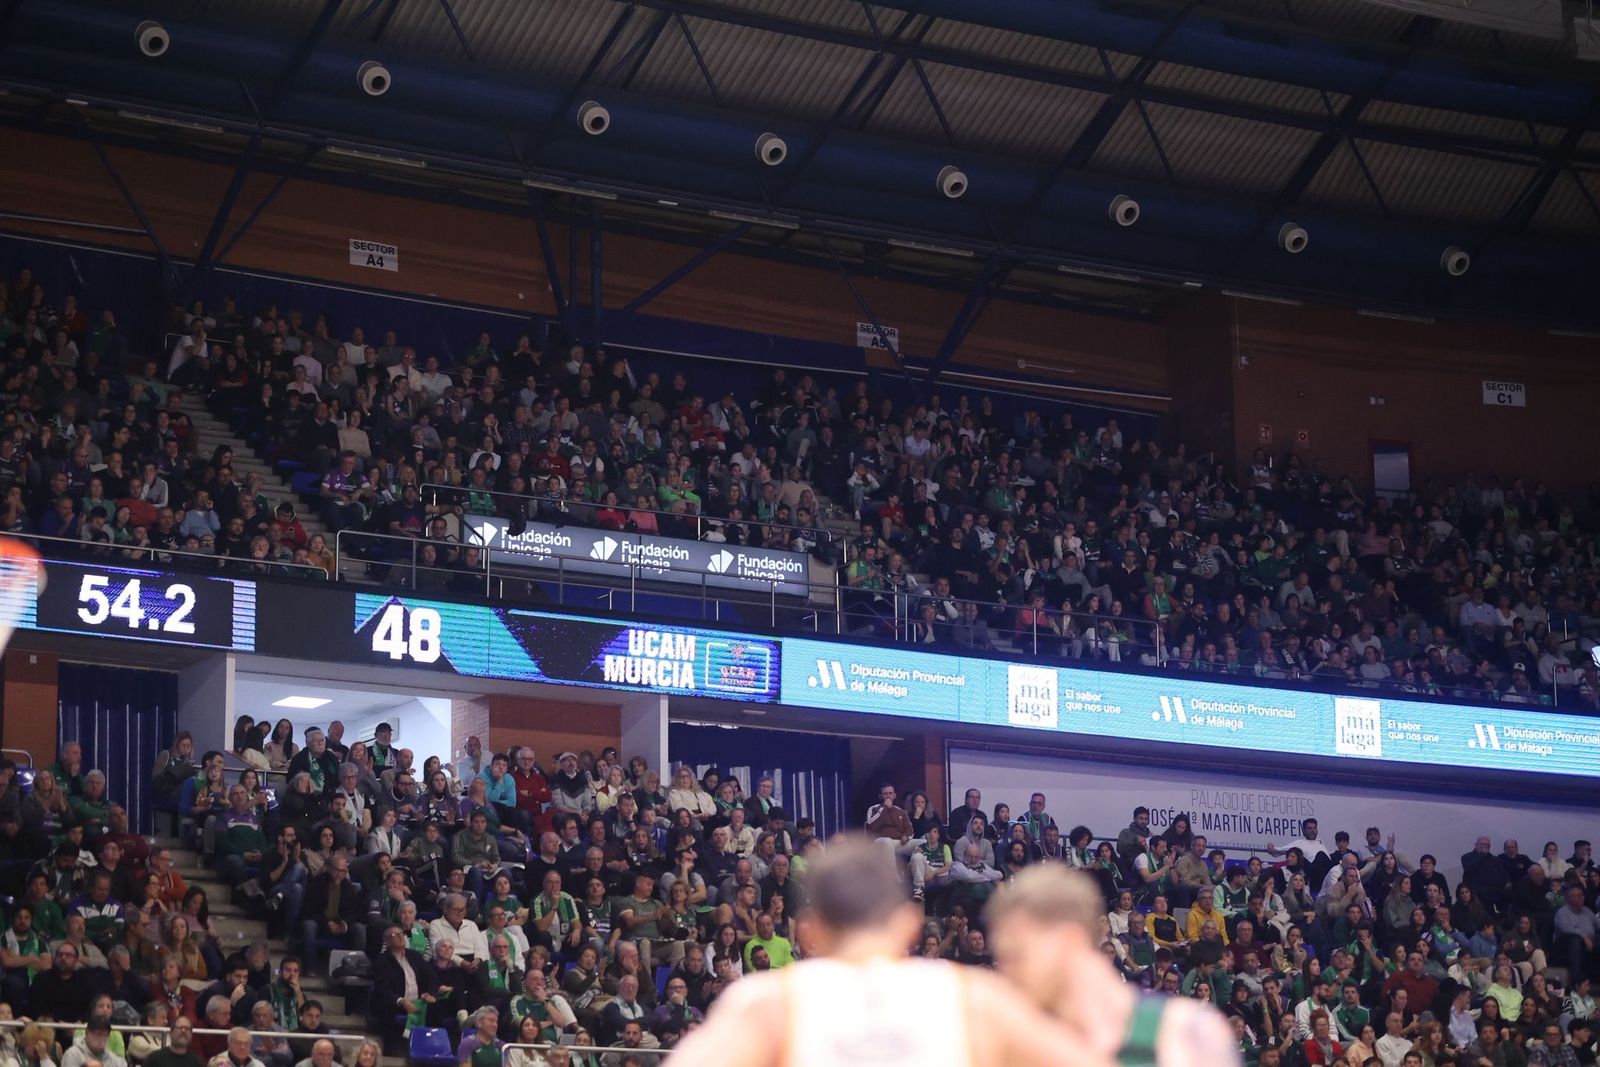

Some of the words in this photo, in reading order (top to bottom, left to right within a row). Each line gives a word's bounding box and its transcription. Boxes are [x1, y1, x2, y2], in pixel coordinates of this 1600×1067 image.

[353, 241, 395, 255] SECTOR
[366, 254, 384, 267] A4
[860, 324, 896, 337] SECTOR
[1486, 383, 1523, 392] SECTOR
[1497, 393, 1512, 404] C1
[621, 541, 689, 560] Fundación
[737, 554, 803, 573] Fundación
[77, 574, 196, 634] 54.2
[372, 604, 441, 663] 48
[628, 629, 696, 661] UCAM
[604, 654, 695, 689] MURCIA
[850, 663, 910, 680] Diputación
[912, 669, 966, 687] Provincial
[850, 680, 865, 692] de
[867, 681, 908, 698] Málaga
[1014, 694, 1051, 722] laga
[1065, 702, 1083, 712] que
[1085, 703, 1102, 712] nos
[1104, 705, 1121, 714] une
[1191, 698, 1246, 714] Diputación
[1247, 704, 1297, 719] Provincial
[1191, 714, 1204, 725] de
[1206, 715, 1244, 731] Málaga
[1503, 726, 1554, 741] Diputación
[1555, 731, 1600, 745] Provincial
[1504, 741, 1517, 752] de
[1518, 741, 1553, 757] Málaga
[1191, 789, 1239, 811] PALACIO
[1241, 793, 1255, 812] DE
[1258, 794, 1315, 816] DEPORTES
[1202, 813, 1252, 834] MARTÍN
